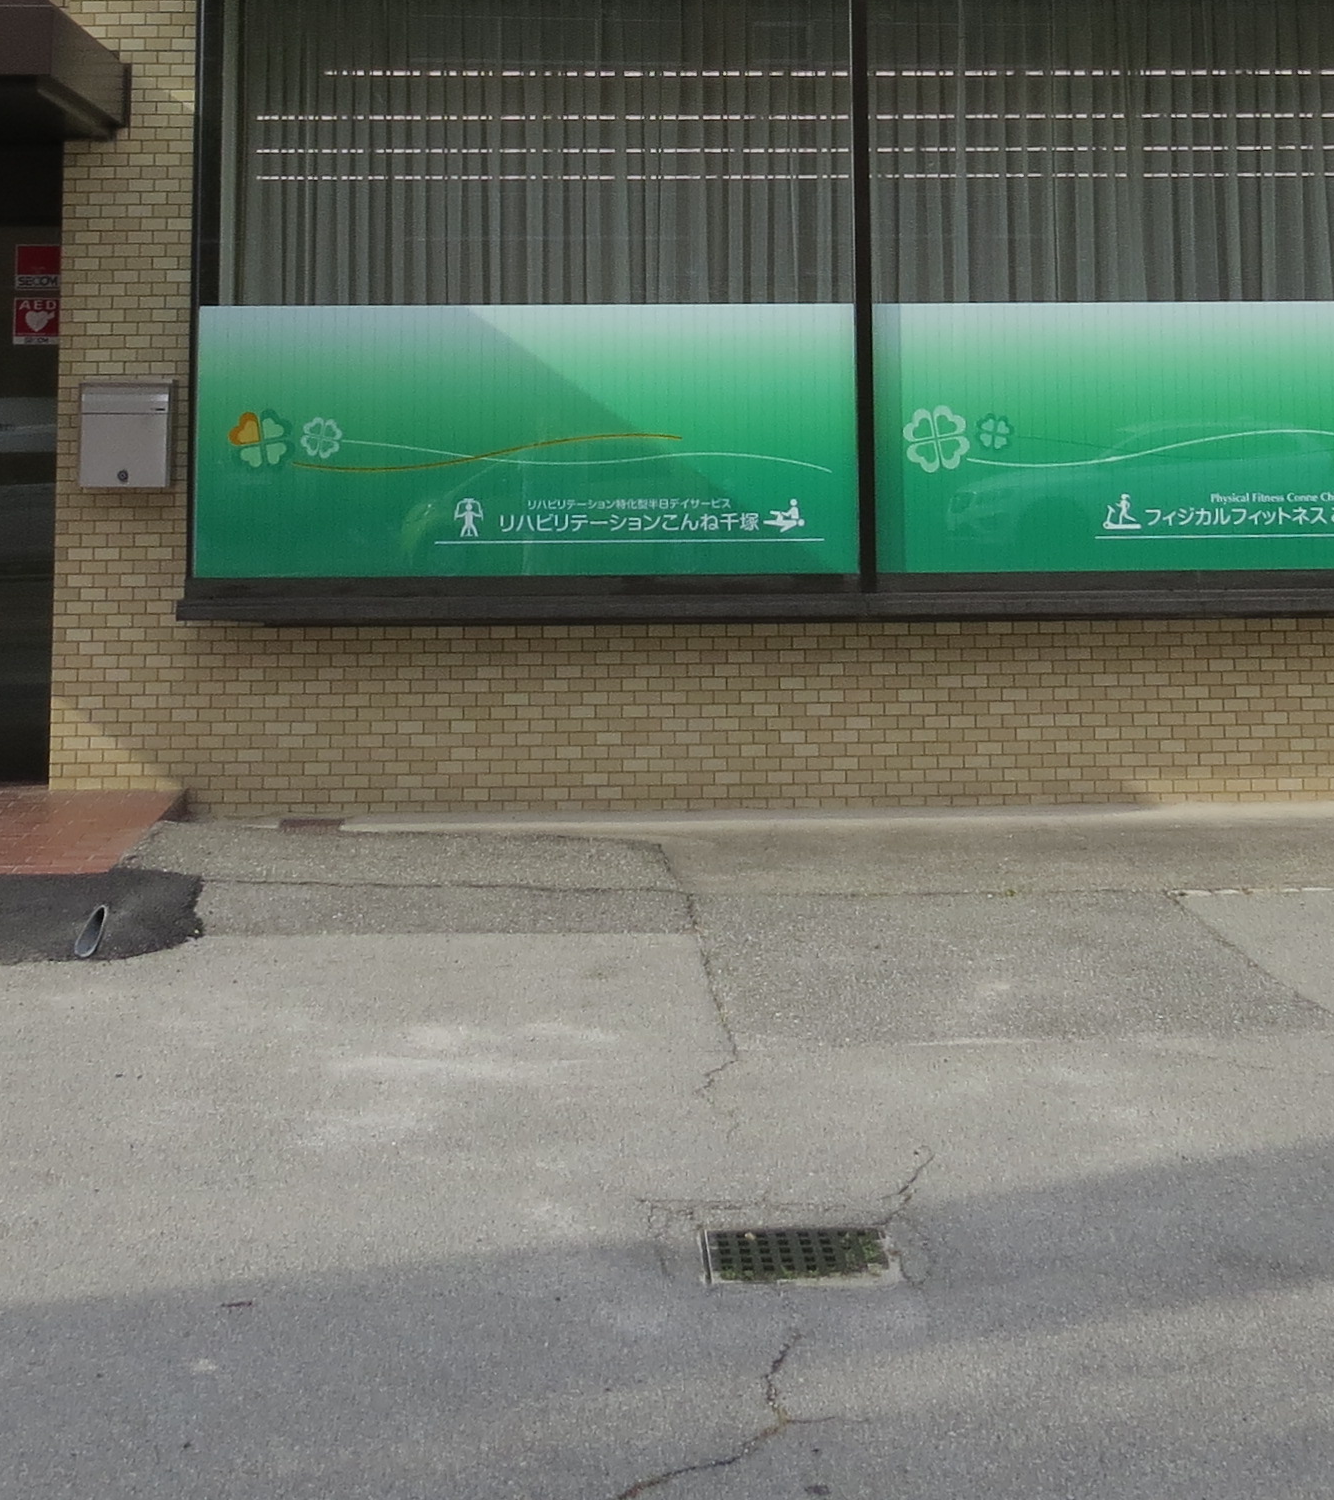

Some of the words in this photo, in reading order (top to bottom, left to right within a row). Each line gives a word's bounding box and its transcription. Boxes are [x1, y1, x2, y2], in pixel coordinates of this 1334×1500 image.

[17, 276, 58, 286] SECOM
[18, 300, 57, 310] AED
[1210, 492, 1249, 503] Physical
[1252, 492, 1285, 502] Fitness
[1287, 492, 1318, 502] Conne
[499, 512, 760, 533] リハビリテーションこんね千塚
